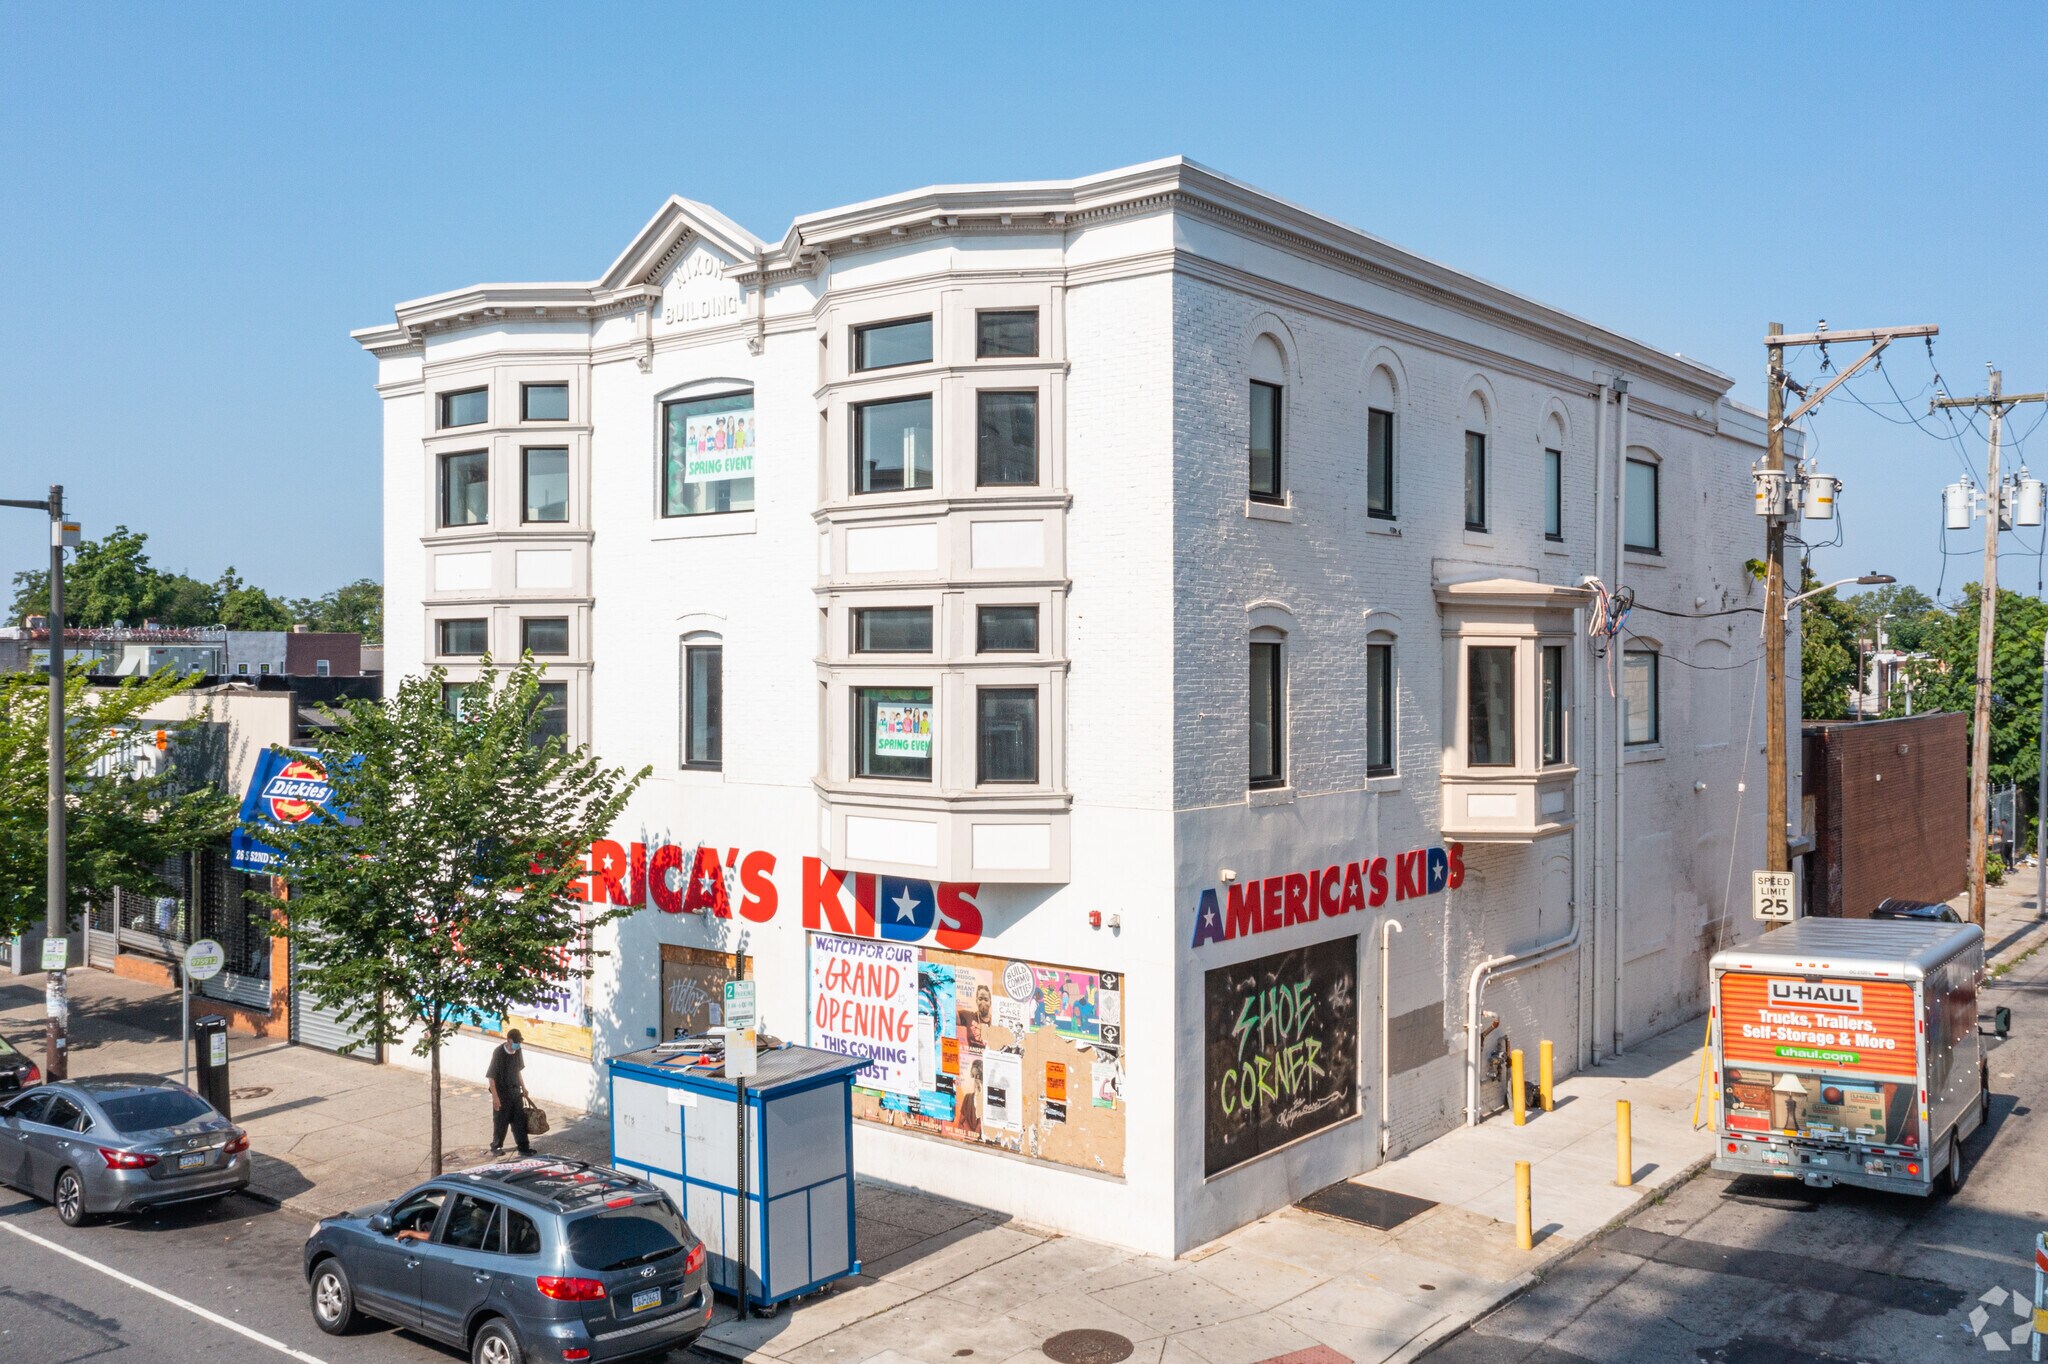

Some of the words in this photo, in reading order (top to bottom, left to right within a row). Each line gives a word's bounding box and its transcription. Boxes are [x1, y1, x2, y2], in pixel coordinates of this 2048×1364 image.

[673, 255, 727, 289] NIXON
[665, 296, 738, 326] BUILDING
[688, 458, 723, 477] SPRING
[724, 455, 753, 472] EVENT
[878, 738, 909, 751] SPRING
[911, 740, 931, 751] EVEN
[270, 780, 327, 798] Dickies
[236, 849, 244, 860] 26
[245, 850, 250, 860] S
[250, 851, 269, 863] 52ND
[1757, 876, 1791, 886] SPEED
[1191, 857, 1389, 949] AMERICA'S
[1395, 842, 1465, 902] KIDS
[1761, 888, 1787, 896] LIMIT
[802, 856, 983, 951] KIDS
[1760, 898, 1789, 916] 25
[815, 936, 858, 956] WATCH
[858, 943, 884, 960] FOR
[885, 946, 913, 963] OUR
[191, 956, 217, 966] 975912
[824, 956, 900, 1001] GRAND
[1006, 965, 1027, 980] BUILD
[726, 985, 734, 998] 2
[1011, 982, 1032, 998] NITIES
[1773, 984, 1858, 1003] U-HAUL
[815, 992, 914, 1043] OPENING
[998, 1006, 1022, 1017] CARE
[1232, 979, 1315, 1063] SHOE
[1758, 1009, 1812, 1028] Trucks,
[1815, 1013, 1877, 1033] Trailers,
[1742, 1024, 1835, 1046] Self-Storage
[1839, 1033, 1851, 1047] &
[1855, 1033, 1896, 1050] More
[822, 1034, 848, 1055] THIS
[849, 1041, 907, 1065] COMING
[1780, 1048, 1854, 1062] uhaul.com
[1221, 1036, 1325, 1115] CORNER
